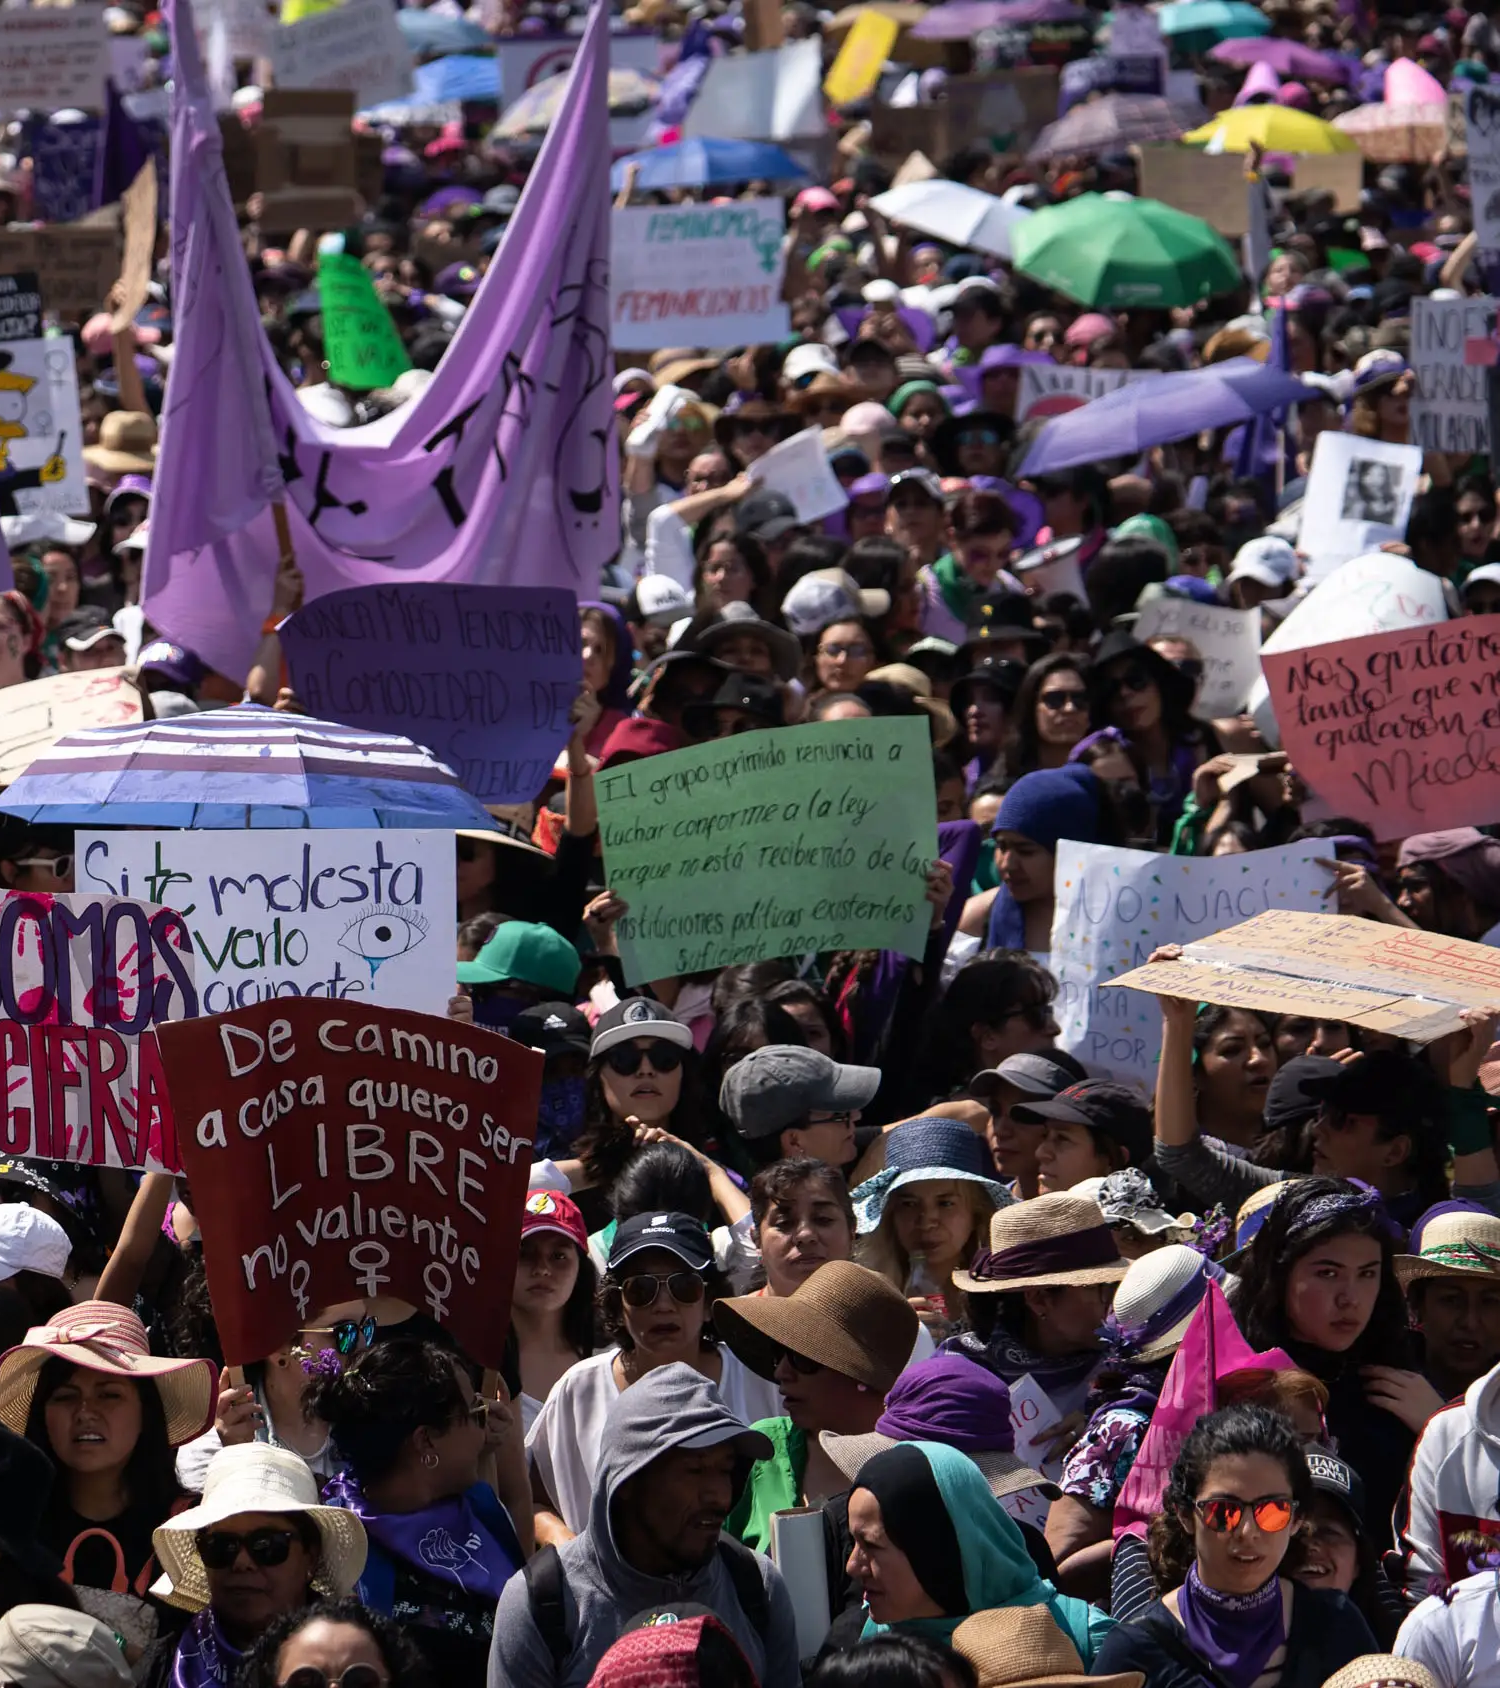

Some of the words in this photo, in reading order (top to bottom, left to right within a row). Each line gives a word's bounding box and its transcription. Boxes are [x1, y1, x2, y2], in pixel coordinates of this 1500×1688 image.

[530, 679, 571, 732] DE
[1412, 676, 1462, 719] que
[650, 765, 709, 805] grupo
[713, 738, 787, 781] oprimido
[795, 737, 875, 764] renuncia
[888, 743, 903, 762] a
[673, 802, 780, 841] conforme
[782, 803, 801, 823] a
[807, 788, 831, 821] la
[837, 784, 879, 828] ley
[209, 839, 423, 917] molesta
[608, 860, 672, 891] porque
[867, 839, 894, 871] de
[1077, 877, 1143, 925] NO
[192, 917, 309, 974] verlo
[219, 1018, 296, 1077] De
[318, 1018, 498, 1084] camino
[1087, 1030, 1147, 1069] POR
[196, 1109, 228, 1148] a
[238, 1074, 326, 1138] casa
[347, 1077, 469, 1131] quiero
[479, 1113, 533, 1166] ser
[267, 1122, 487, 1225] LIBRE
[241, 1234, 289, 1291] no
[296, 1190, 481, 1286] valiente
